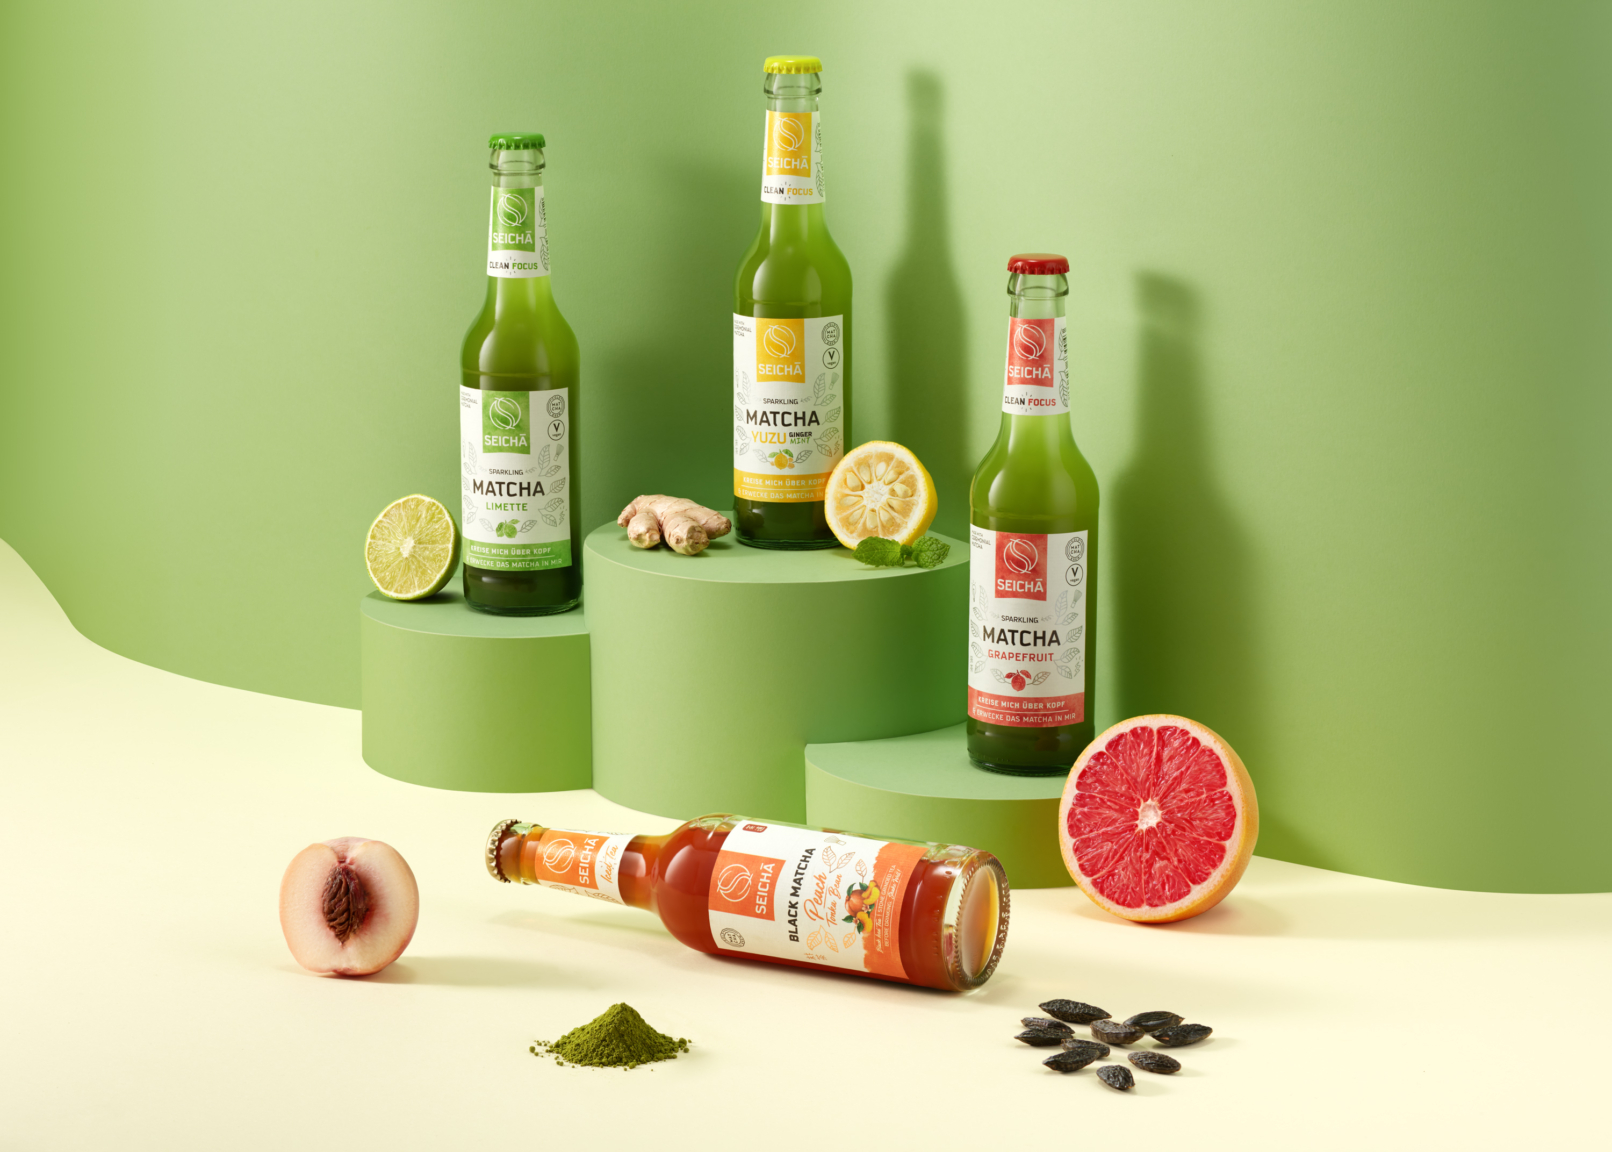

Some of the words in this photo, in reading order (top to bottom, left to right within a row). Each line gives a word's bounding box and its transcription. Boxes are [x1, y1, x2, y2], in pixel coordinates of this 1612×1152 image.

[768, 156, 808, 169] SEICHĀ
[764, 186, 784, 194] CLEAN
[493, 231, 533, 244] SEICHĀ
[828, 351, 835, 360] V
[759, 362, 802, 375] SEICHĀ
[1009, 365, 1051, 378] SEICHĀ
[1005, 396, 1025, 405] CLEAN
[746, 409, 820, 427] MATCHA
[554, 423, 560, 432] V
[485, 434, 527, 447] SEICHĀ
[751, 430, 786, 444] YUZU
[743, 477, 763, 485] KREISE
[473, 479, 545, 497] MATCHA
[742, 489, 768, 498] ERWECKE
[486, 502, 528, 511] LIMETTE
[471, 545, 489, 553] KREISE
[470, 557, 494, 566] ERWECKE
[1071, 567, 1078, 577] V
[997, 578, 1044, 592] SEICHĀ
[1001, 615, 1039, 623] SPARKLING
[983, 625, 1061, 647] MATCHA
[988, 649, 1054, 662] GRAPEFRUIT
[979, 697, 998, 706] KREISE
[1022, 701, 1043, 709] ÜBER
[977, 709, 1003, 720] ERWECKE
[606, 845, 618, 860] Tea
[578, 838, 599, 884] SEICHĀ
[600, 862, 613, 884] Iced
[790, 848, 816, 897] MATCHA
[755, 862, 775, 914] SEICHĀ
[828, 874, 842, 899] Bean
[804, 872, 827, 921] Peach
[826, 900, 838, 927] Tonka
[788, 900, 800, 942] BLACK
